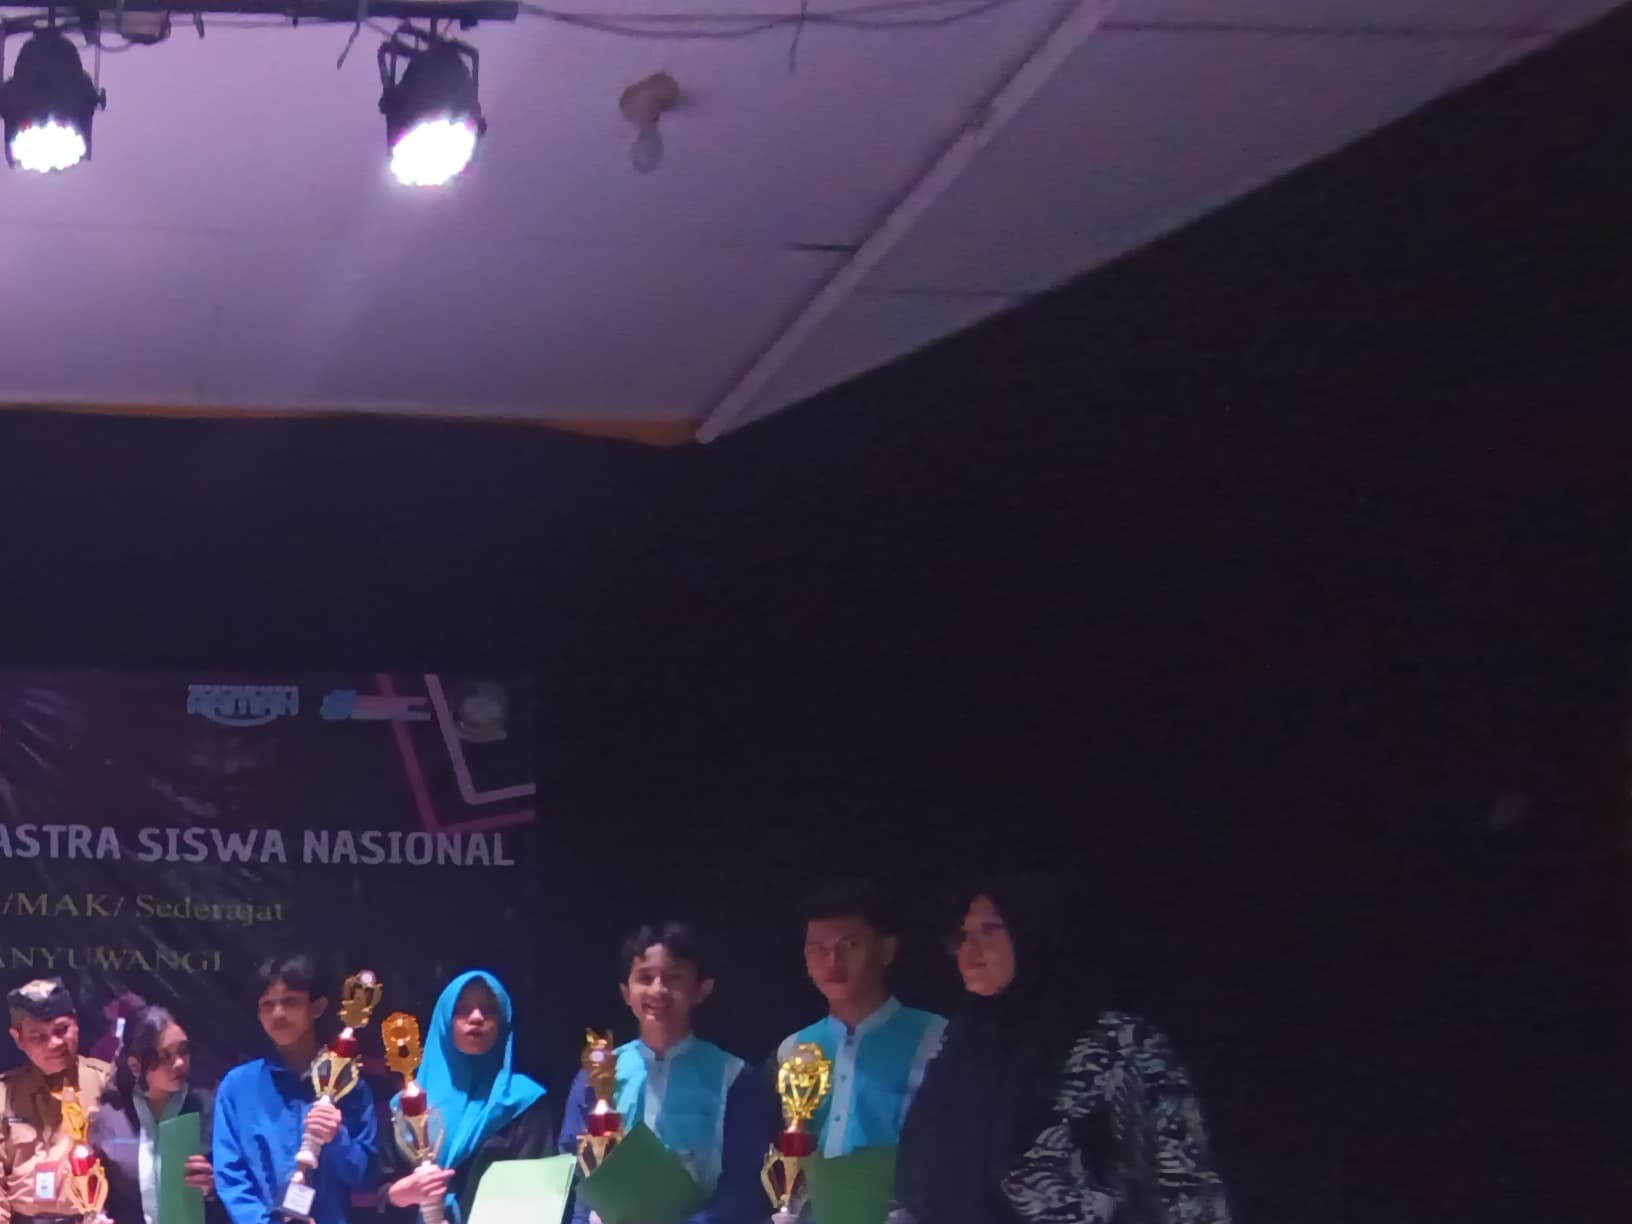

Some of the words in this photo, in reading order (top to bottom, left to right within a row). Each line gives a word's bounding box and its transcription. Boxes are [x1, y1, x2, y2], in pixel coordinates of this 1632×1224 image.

[136, 828, 287, 863] SISWA
[303, 830, 515, 867] NASIONAL
[134, 894, 286, 926] Sederajat
